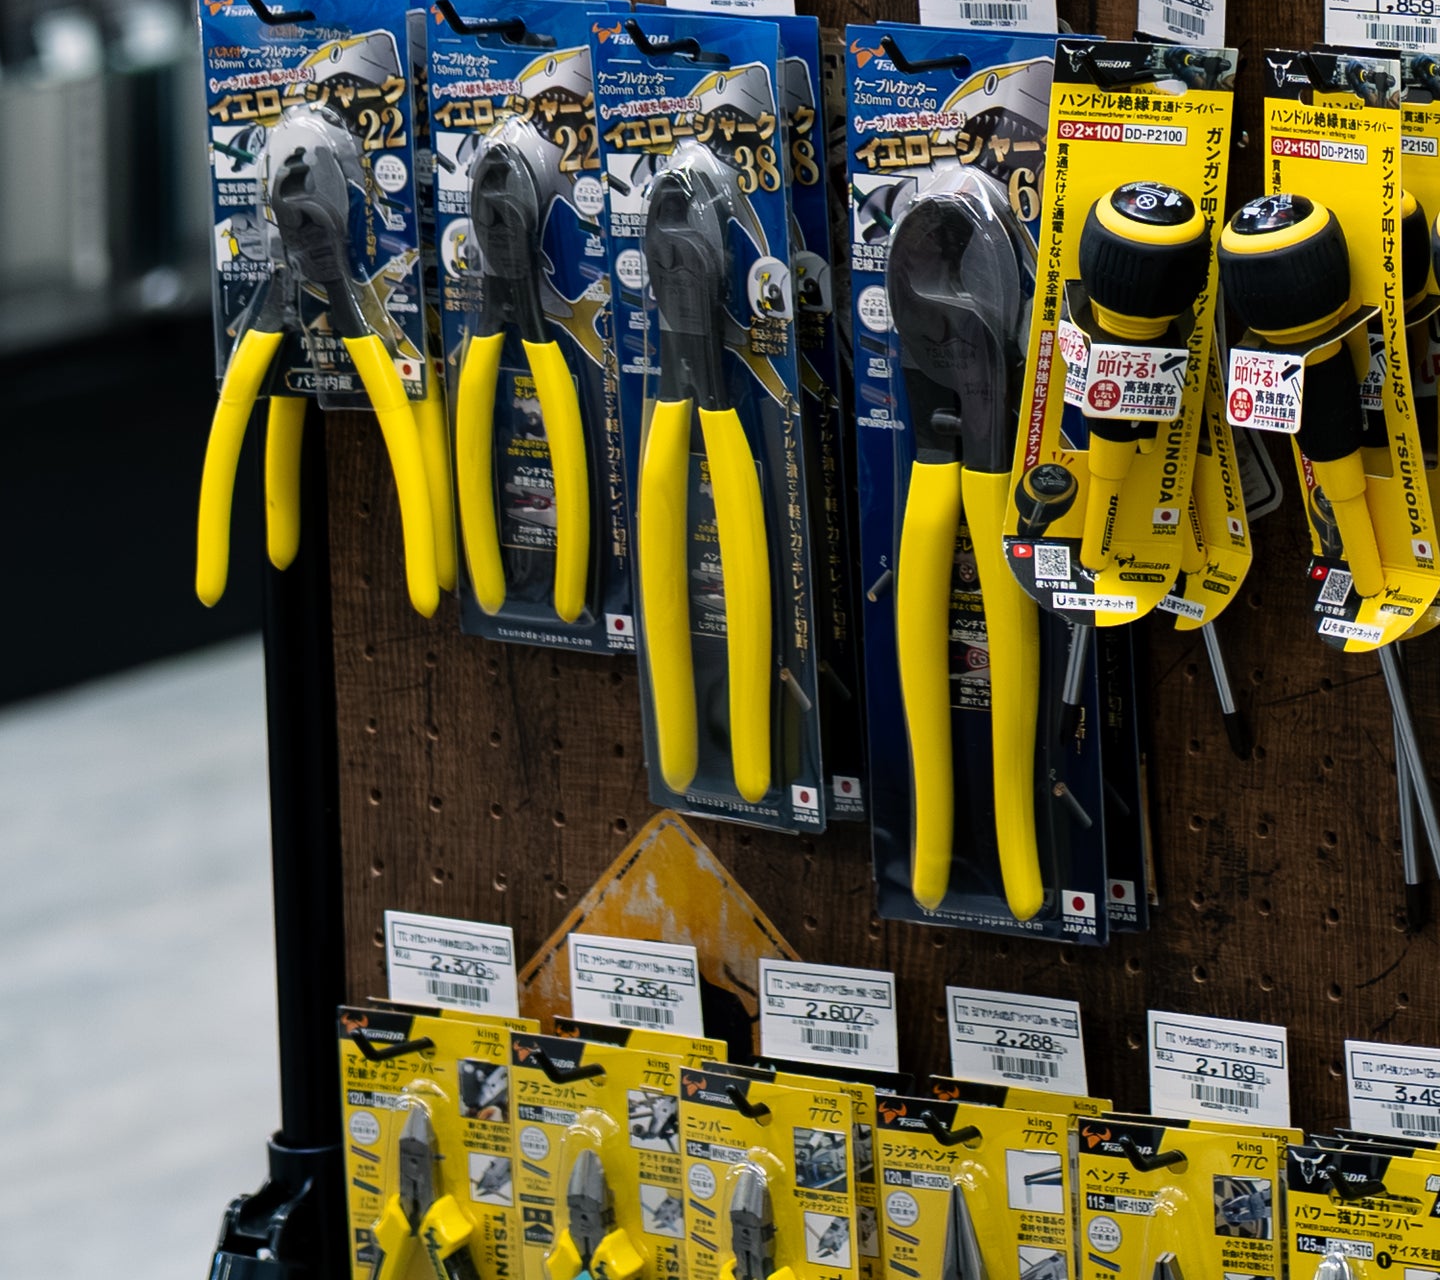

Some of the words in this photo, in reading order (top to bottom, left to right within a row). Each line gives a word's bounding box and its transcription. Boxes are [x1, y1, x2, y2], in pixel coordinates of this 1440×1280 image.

[597, 70, 674, 86] ケーブルカッター
[854, 77, 937, 94] ケーブルカッター
[598, 84, 635, 97] 200mm
[854, 93, 893, 106] 250mm
[897, 96, 937, 110] OCA-60
[358, 107, 407, 152] 22
[603, 109, 776, 152] イエローシャーク
[1125, 127, 1184, 144] DD-P2100
[1321, 145, 1366, 162] DD-P2150
[735, 142, 781, 195] 38
[1097, 349, 1152, 364] ハンマーで
[1123, 380, 1178, 395] 高強度な
[1122, 393, 1176, 407] FRP材採用
[1396, 432, 1420, 536] TSUNODA
[1063, 924, 1096, 936] JAPAN
[812, 1095, 837, 1109] king
[809, 1107, 843, 1124] TTC
[1027, 1117, 1052, 1130] king
[687, 1118, 732, 1134] ニッパー
[1022, 1131, 1058, 1145] TTC
[881, 1144, 959, 1163] ラジオペンチ
[1236, 1141, 1263, 1154] king
[1231, 1155, 1267, 1170] TTC
[1086, 1168, 1130, 1184] ペンチ
[1295, 1204, 1423, 1230] パワー強力ニッパー
